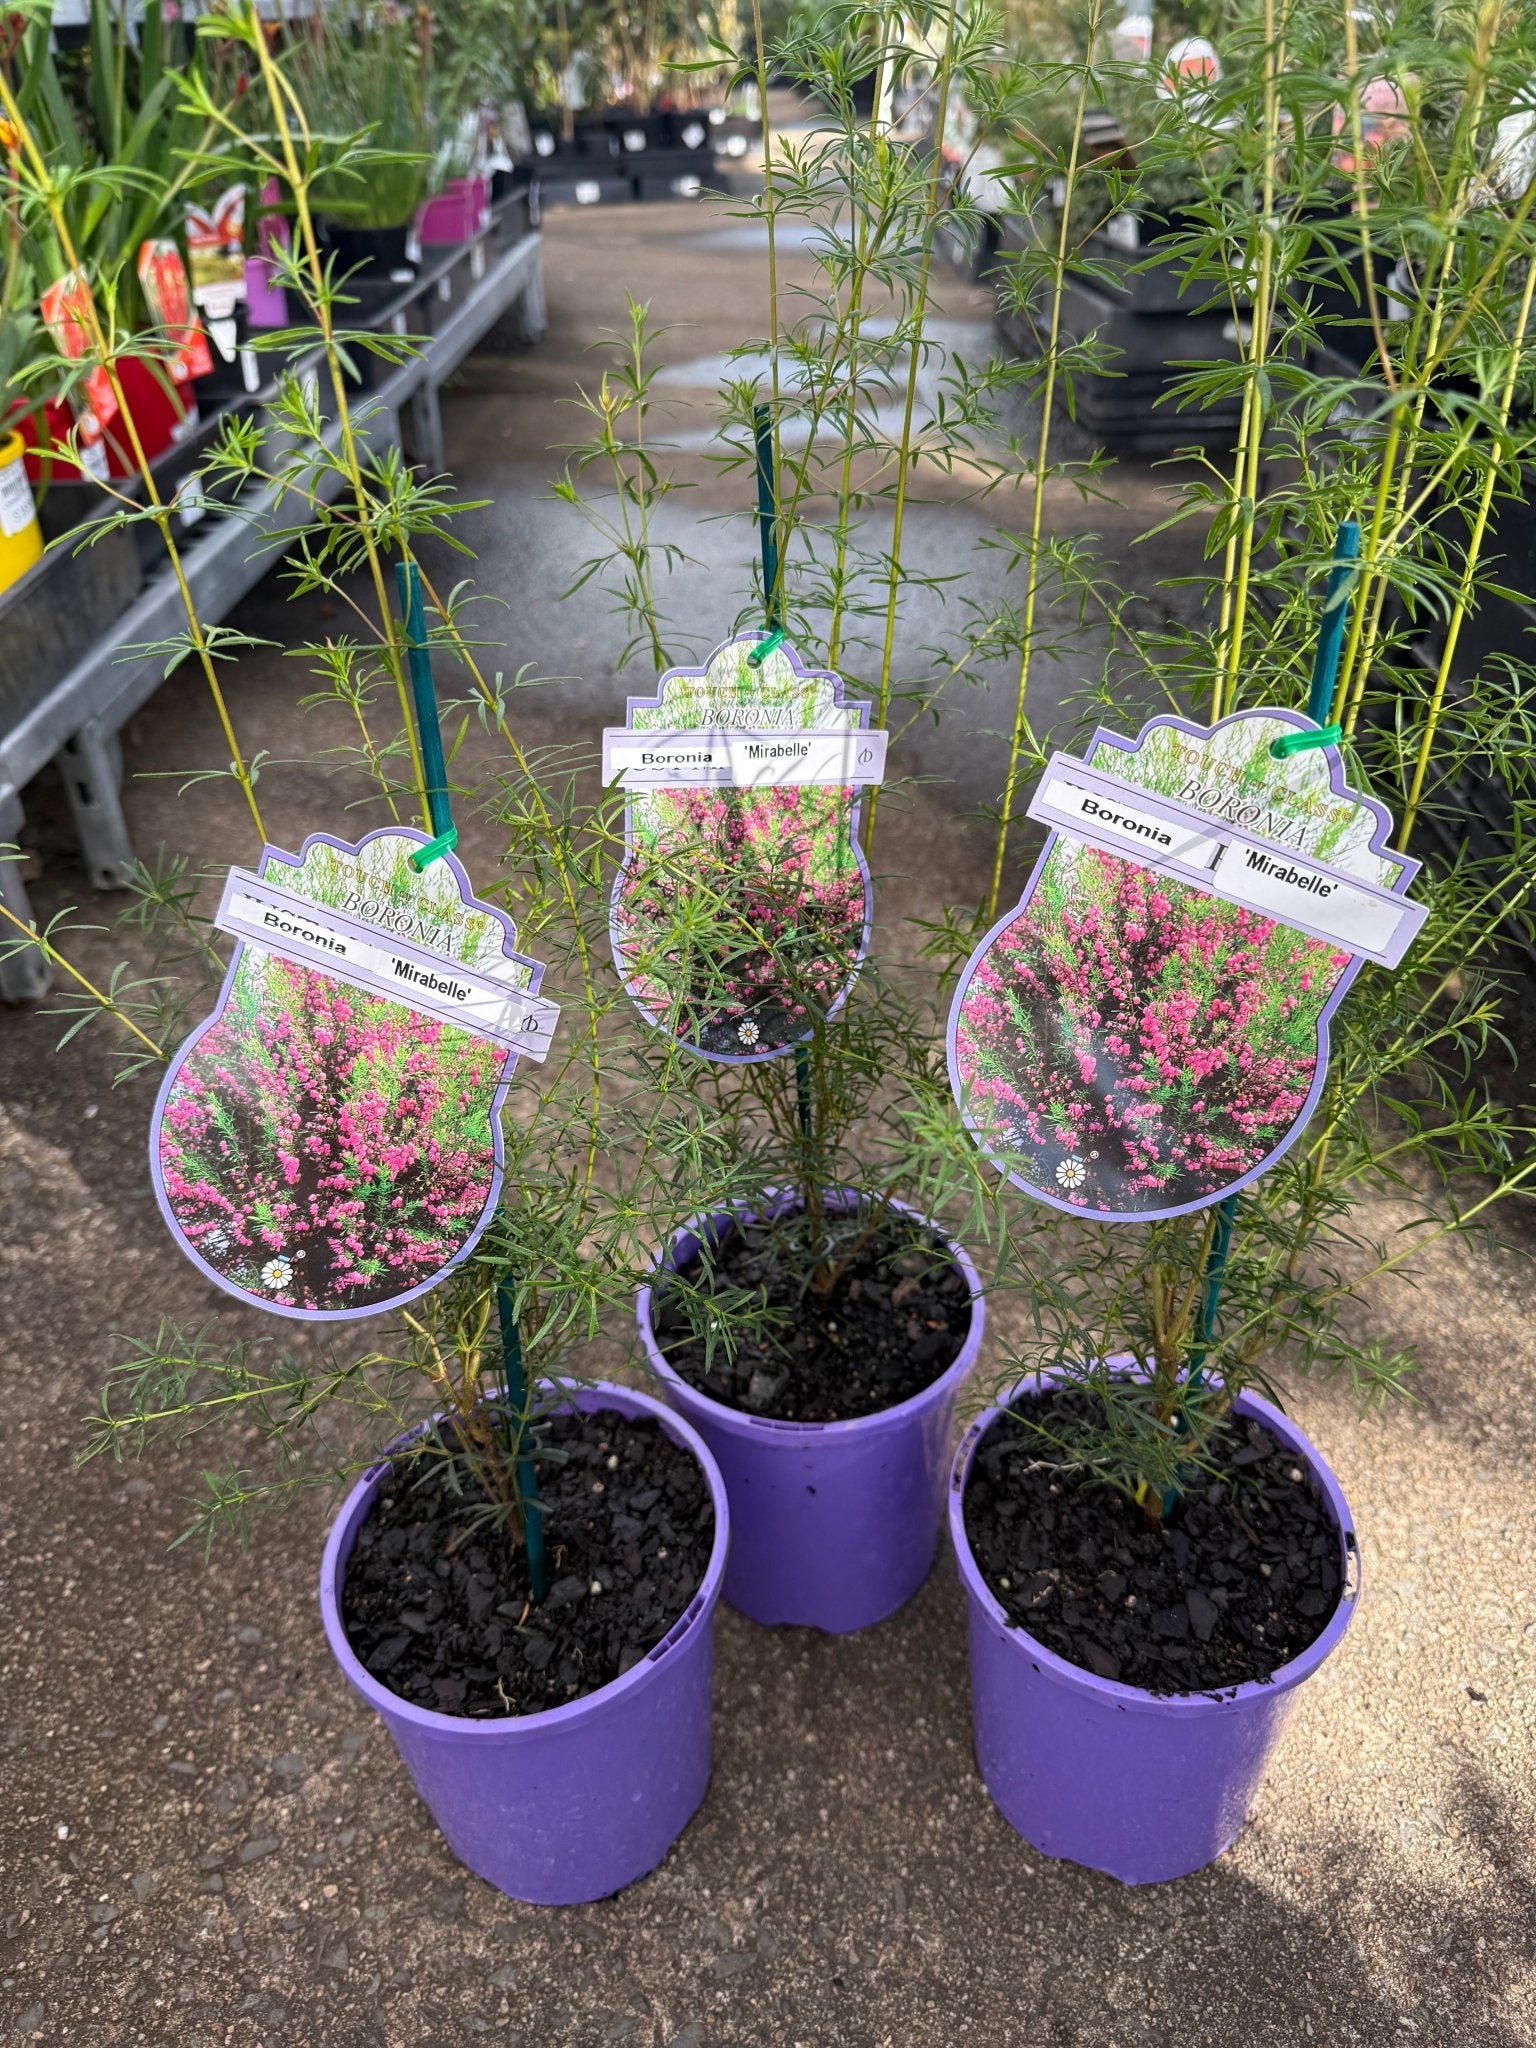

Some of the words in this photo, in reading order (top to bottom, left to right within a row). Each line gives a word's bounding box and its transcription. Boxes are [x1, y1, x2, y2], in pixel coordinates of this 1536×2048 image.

[701, 708, 794, 726] BORONIA
[641, 752, 713, 765] Boronia
[744, 741, 812, 760] 'Mirabelle'
[1173, 743, 1247, 785] TOUCH
[1177, 779, 1308, 847] BORONIA
[1080, 798, 1173, 847] Boronia
[1244, 848, 1340, 899] 'Mirabelle'
[331, 858, 394, 896] TOUCH
[342, 891, 452, 953] BORONIA
[263, 911, 347, 956] Boronia
[391, 957, 472, 1001] 'Mirabelle'
